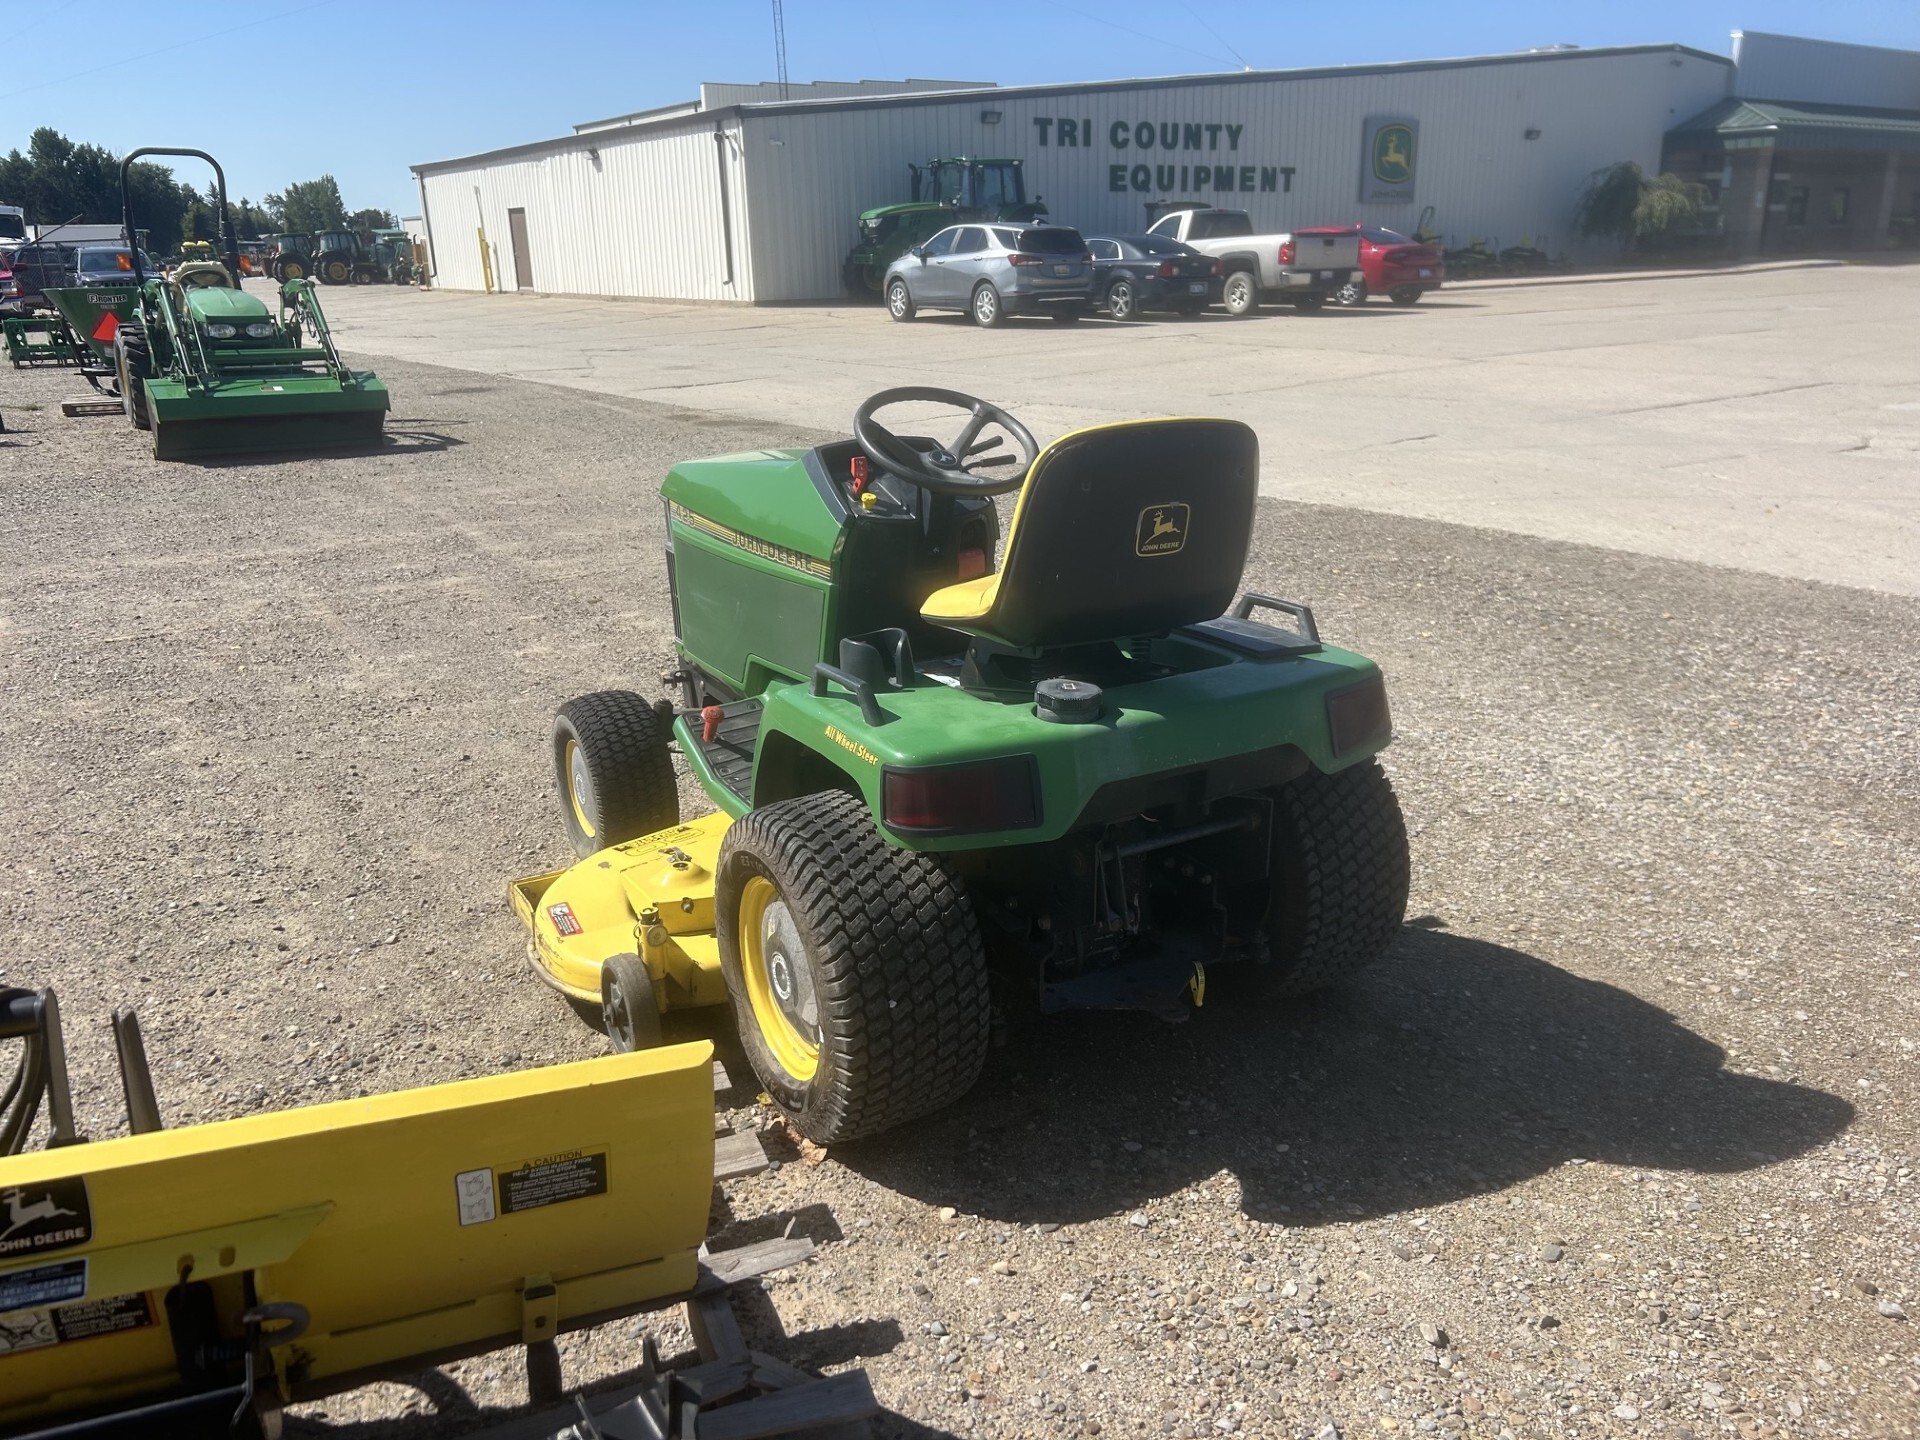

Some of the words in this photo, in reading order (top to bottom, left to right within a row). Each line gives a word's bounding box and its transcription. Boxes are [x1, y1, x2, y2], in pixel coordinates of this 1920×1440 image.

[1033, 117, 1092, 147] TRI
[1109, 120, 1244, 151] COUNTY
[1109, 164, 1296, 194] EQUIPMENT
[88, 293, 127, 303] FRONTIER
[732, 531, 764, 557] JOHN
[1141, 544, 1159, 552] JOHN
[1160, 542, 1180, 550] DEERE
[824, 725, 836, 740] All
[836, 730, 859, 753] Wheel
[858, 745, 879, 766] Steer
[512, 1168, 529, 1177] HELP
[530, 1164, 550, 1174] AVOID
[574, 1156, 592, 1166] FROM
[534, 1150, 582, 1166] CAUTION
[529, 1168, 555, 1178] SUDDEN
[556, 1164, 577, 1174] STOPS
[0, 1236, 31, 1253] OHN
[34, 1227, 85, 1246] DEERE
